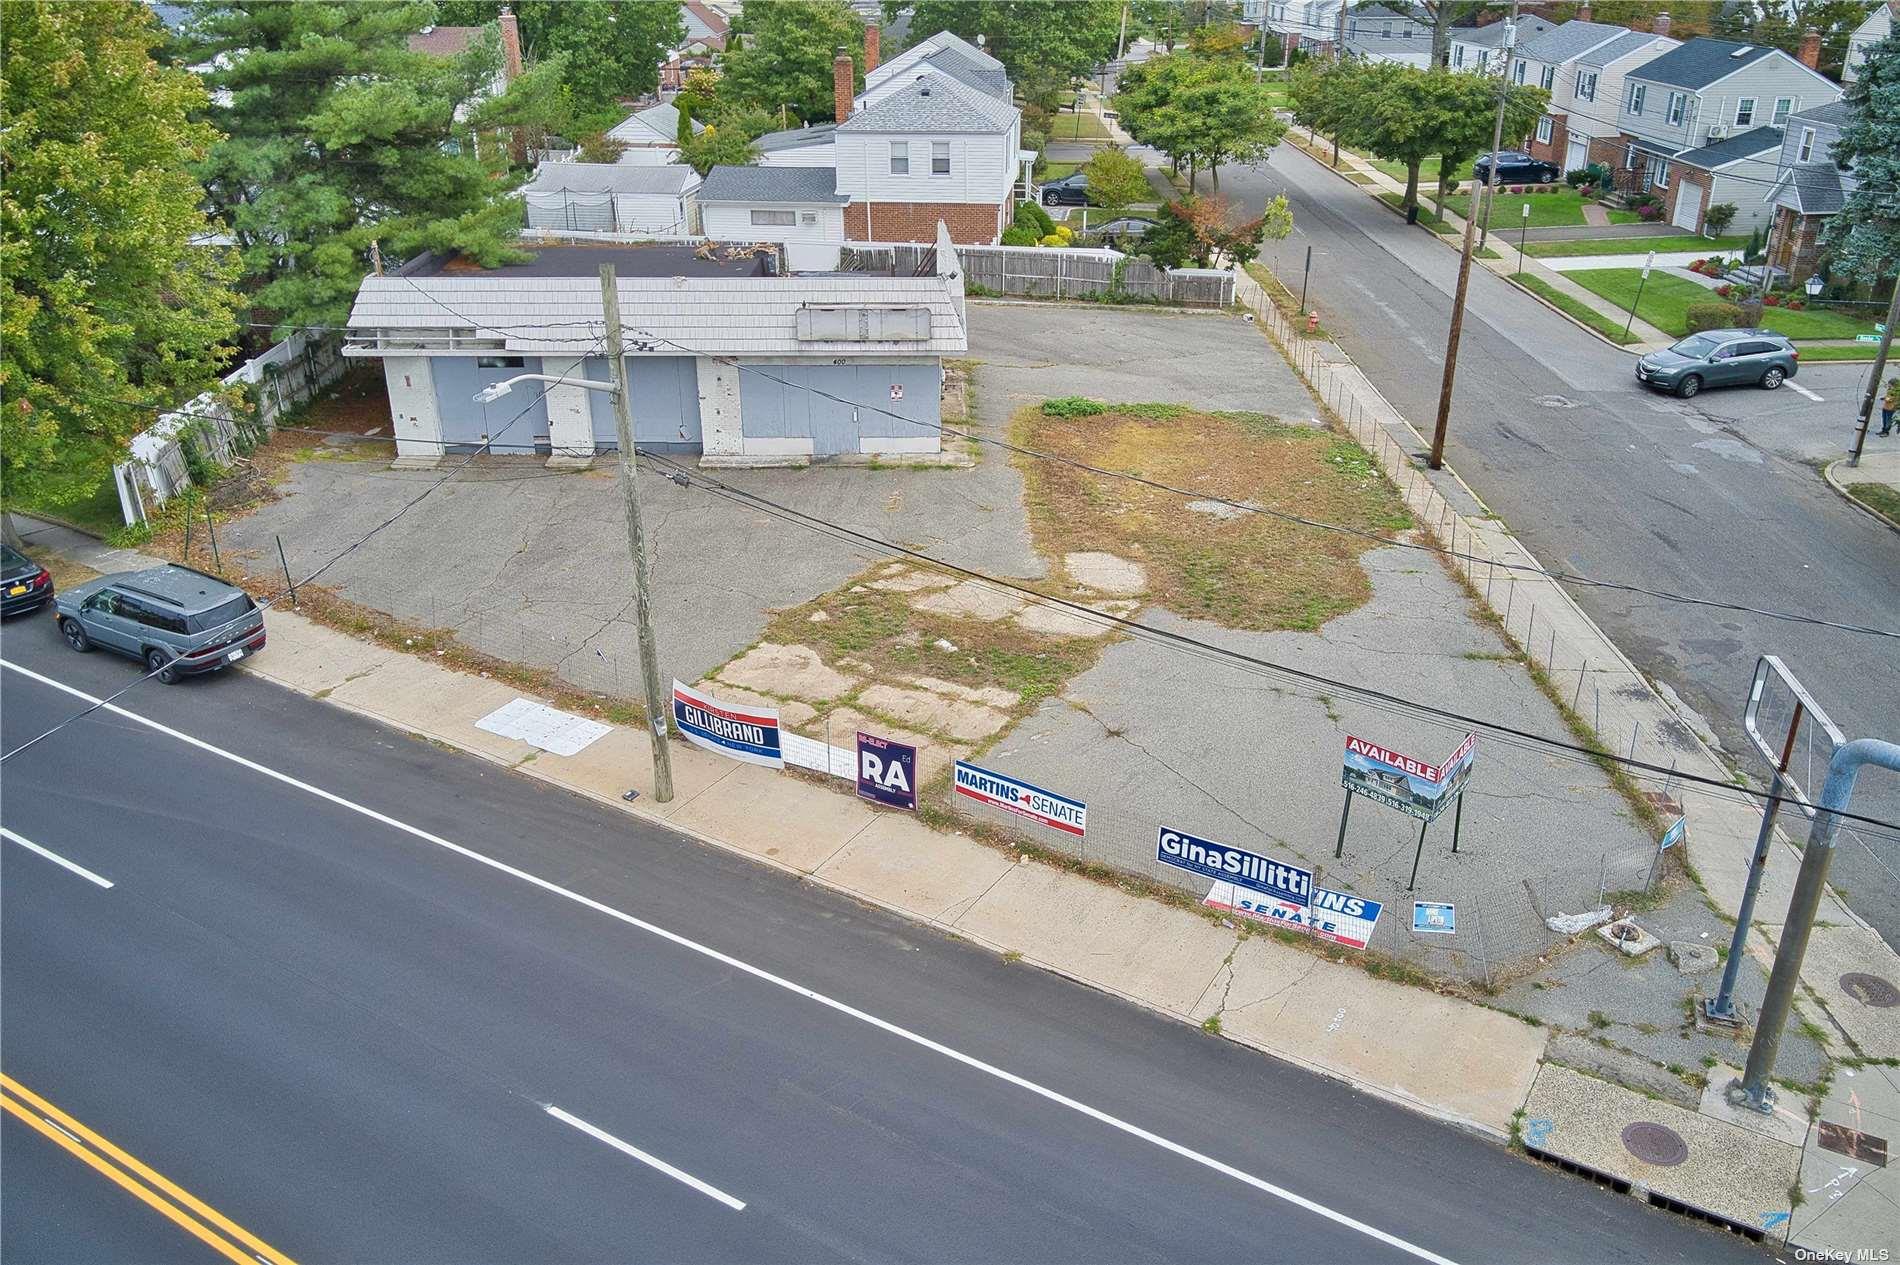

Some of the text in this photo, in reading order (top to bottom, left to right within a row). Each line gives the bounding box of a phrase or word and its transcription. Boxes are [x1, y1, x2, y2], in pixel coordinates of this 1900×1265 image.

[685, 706, 764, 744] GILLIBRAND
[704, 704, 737, 720] KIRSTEN
[862, 750, 910, 792] RA
[902, 754, 911, 763] Ed
[1348, 739, 1437, 781] AVAILABLE
[1440, 734, 1476, 780] AVAILABLE
[957, 768, 1083, 825] MARTINS SENATE
[1161, 832, 1309, 896] GinaSillitti
[1241, 900, 1337, 932] SENATE
[1314, 889, 1365, 916] INS
